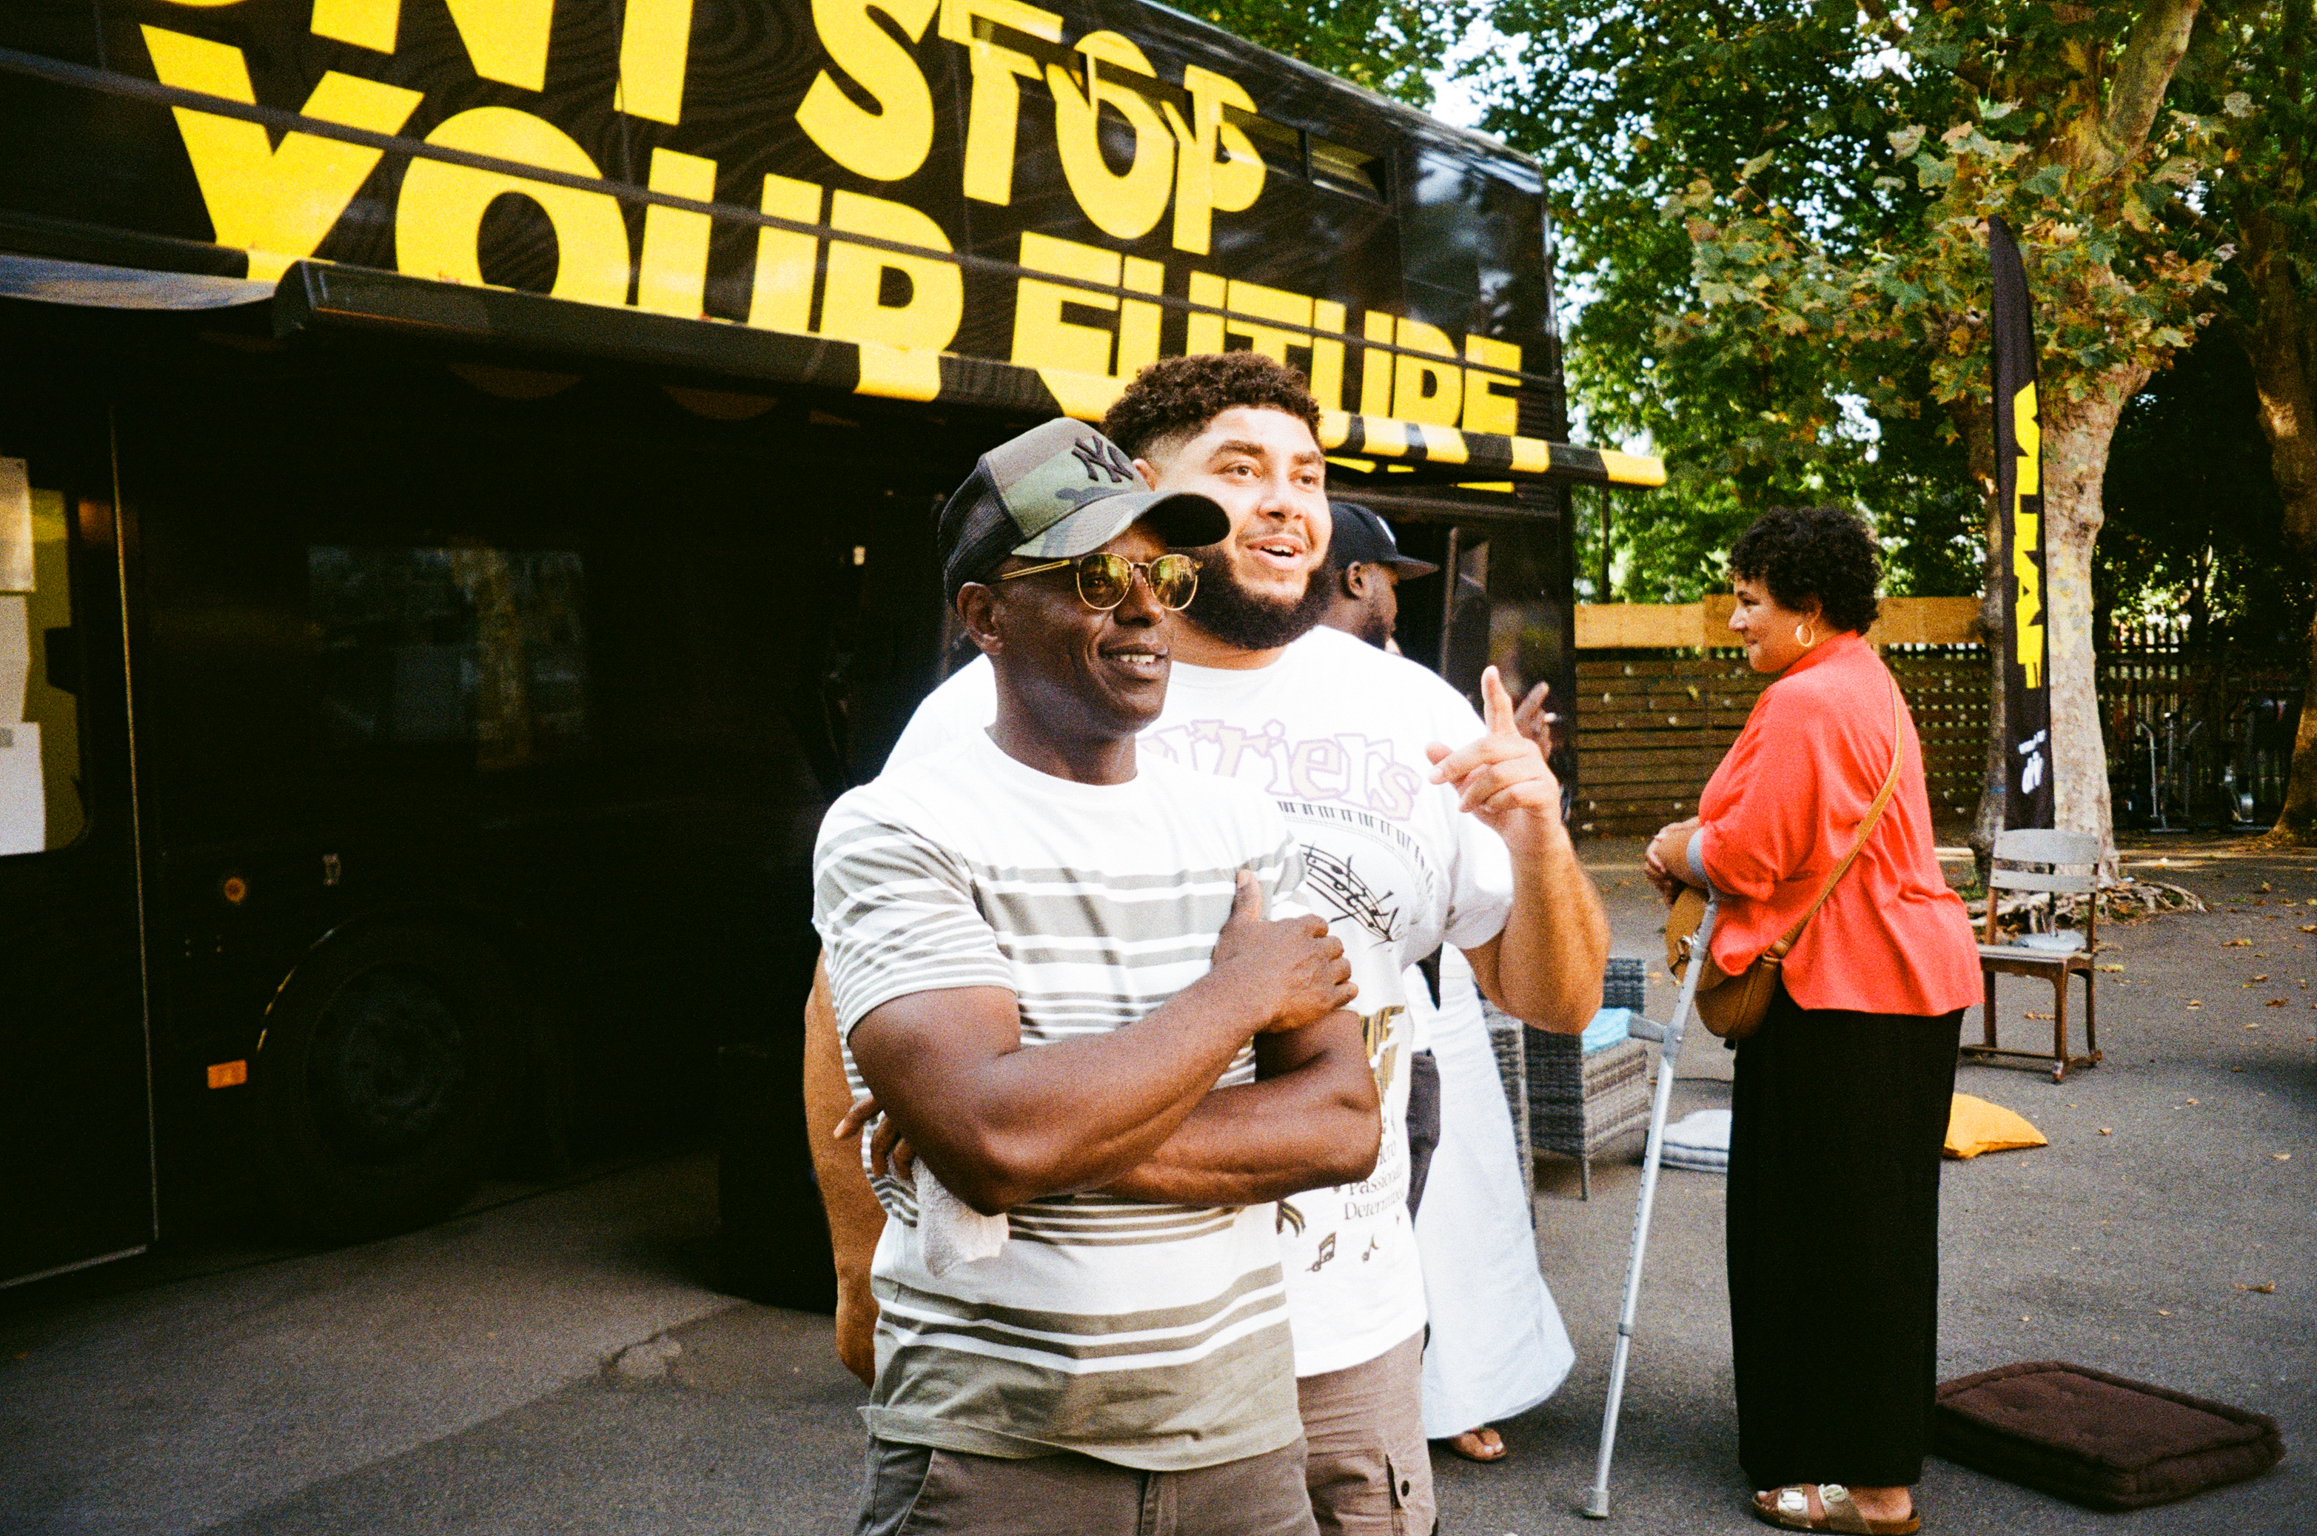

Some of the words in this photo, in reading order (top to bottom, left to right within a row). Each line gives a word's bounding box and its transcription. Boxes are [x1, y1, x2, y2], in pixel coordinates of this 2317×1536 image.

[140, 24, 964, 400] YOUR
[1010, 230, 1522, 470] FUTURE
[795, 0, 1266, 255] STOP
[1136, 718, 1422, 822] rriers
